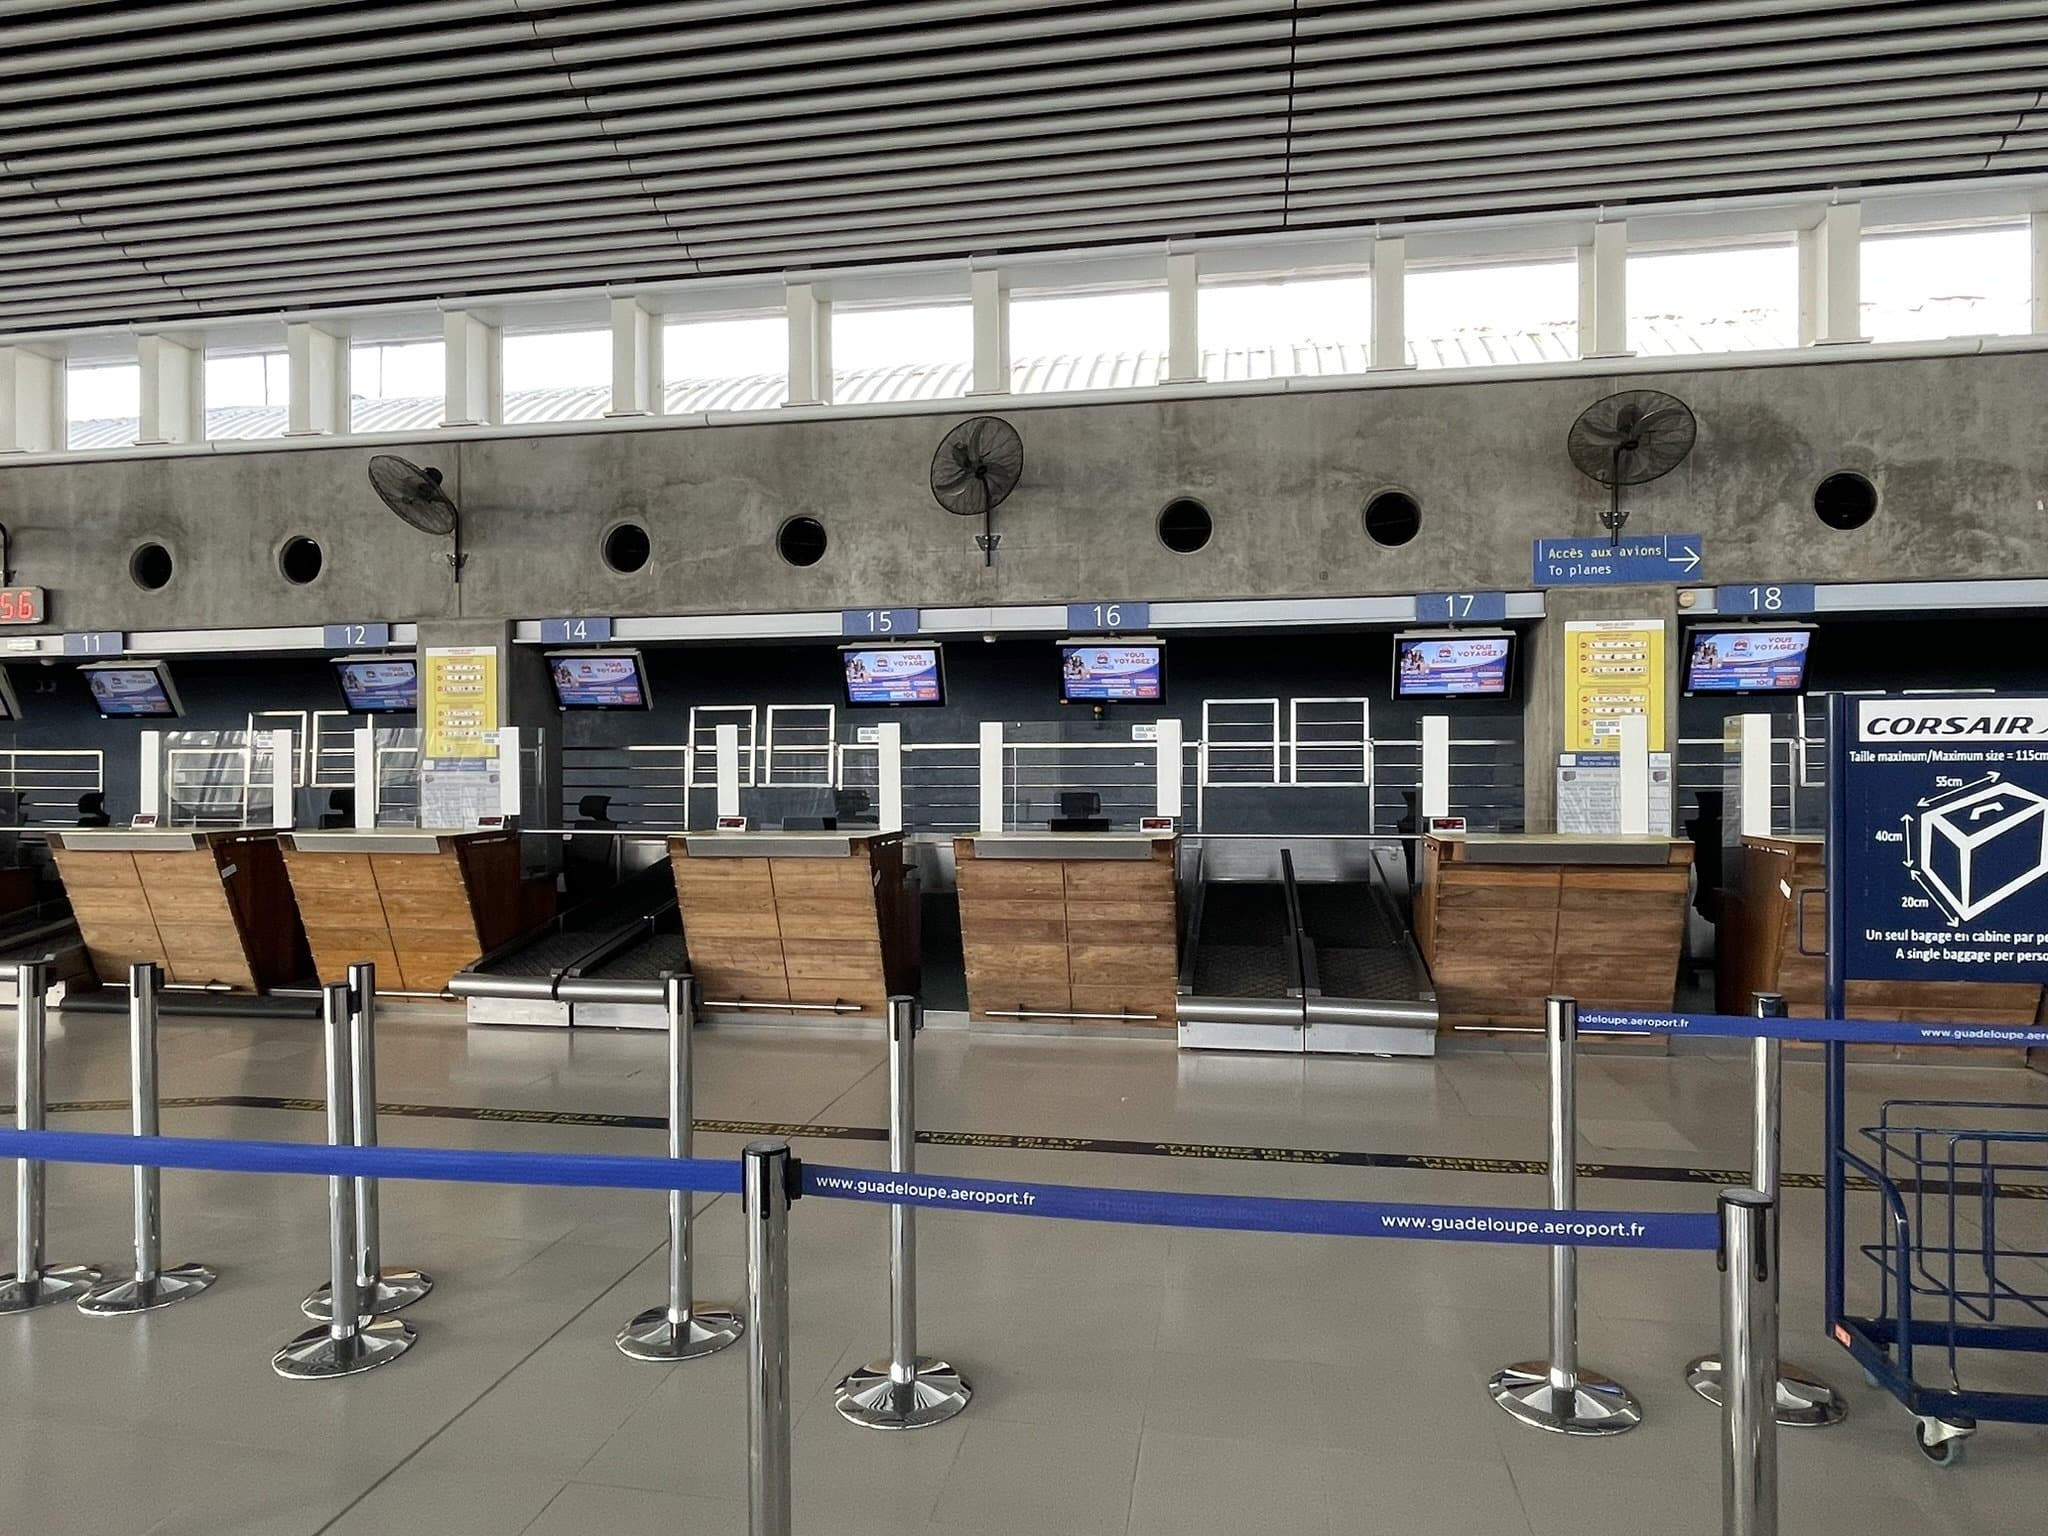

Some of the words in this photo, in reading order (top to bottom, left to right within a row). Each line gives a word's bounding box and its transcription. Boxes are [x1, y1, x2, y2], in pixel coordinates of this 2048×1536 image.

[1549, 547, 1583, 559] Accès
[1590, 549, 1612, 558] aux
[1619, 546, 1662, 557] avions
[1549, 565, 1563, 576] To
[1569, 565, 1612, 577] planes
[1445, 595, 1474, 617] 17
[1749, 587, 1782, 610] 18
[866, 611, 892, 632] 15
[1093, 604, 1121, 627] 16
[344, 626, 366, 645] 12
[563, 620, 587, 640] 14
[82, 635, 100, 652] 11
[1754, 643, 1797, 651] VOYAGEZ
[1867, 717, 2034, 735] CORSAIR
[1850, 750, 1876, 762] Taille
[1878, 749, 1983, 763] maximum/Maximum
[1985, 750, 2005, 761] size
[1936, 776, 1963, 787] 55cm
[1875, 831, 1903, 842] 40cm
[1901, 897, 1929, 908] 20cm
[1866, 929, 1879, 941] Un
[1885, 929, 1909, 941] seul
[1911, 929, 1951, 944] bagage
[1955, 931, 1969, 942] en
[1972, 930, 2011, 943] cabine
[2013, 933, 2034, 945] par
[1895, 948, 1905, 959] A
[1907, 949, 1940, 962] single
[1943, 949, 1991, 963] baggage
[1994, 951, 2014, 963] per
[1154, 1144, 1255, 1154] ATTENDEZ
[816, 1176, 1036, 1205] www.guadeloupe.aeroport.fr
[1381, 1215, 1646, 1237] www.guadeloupe.aeroport.fr
